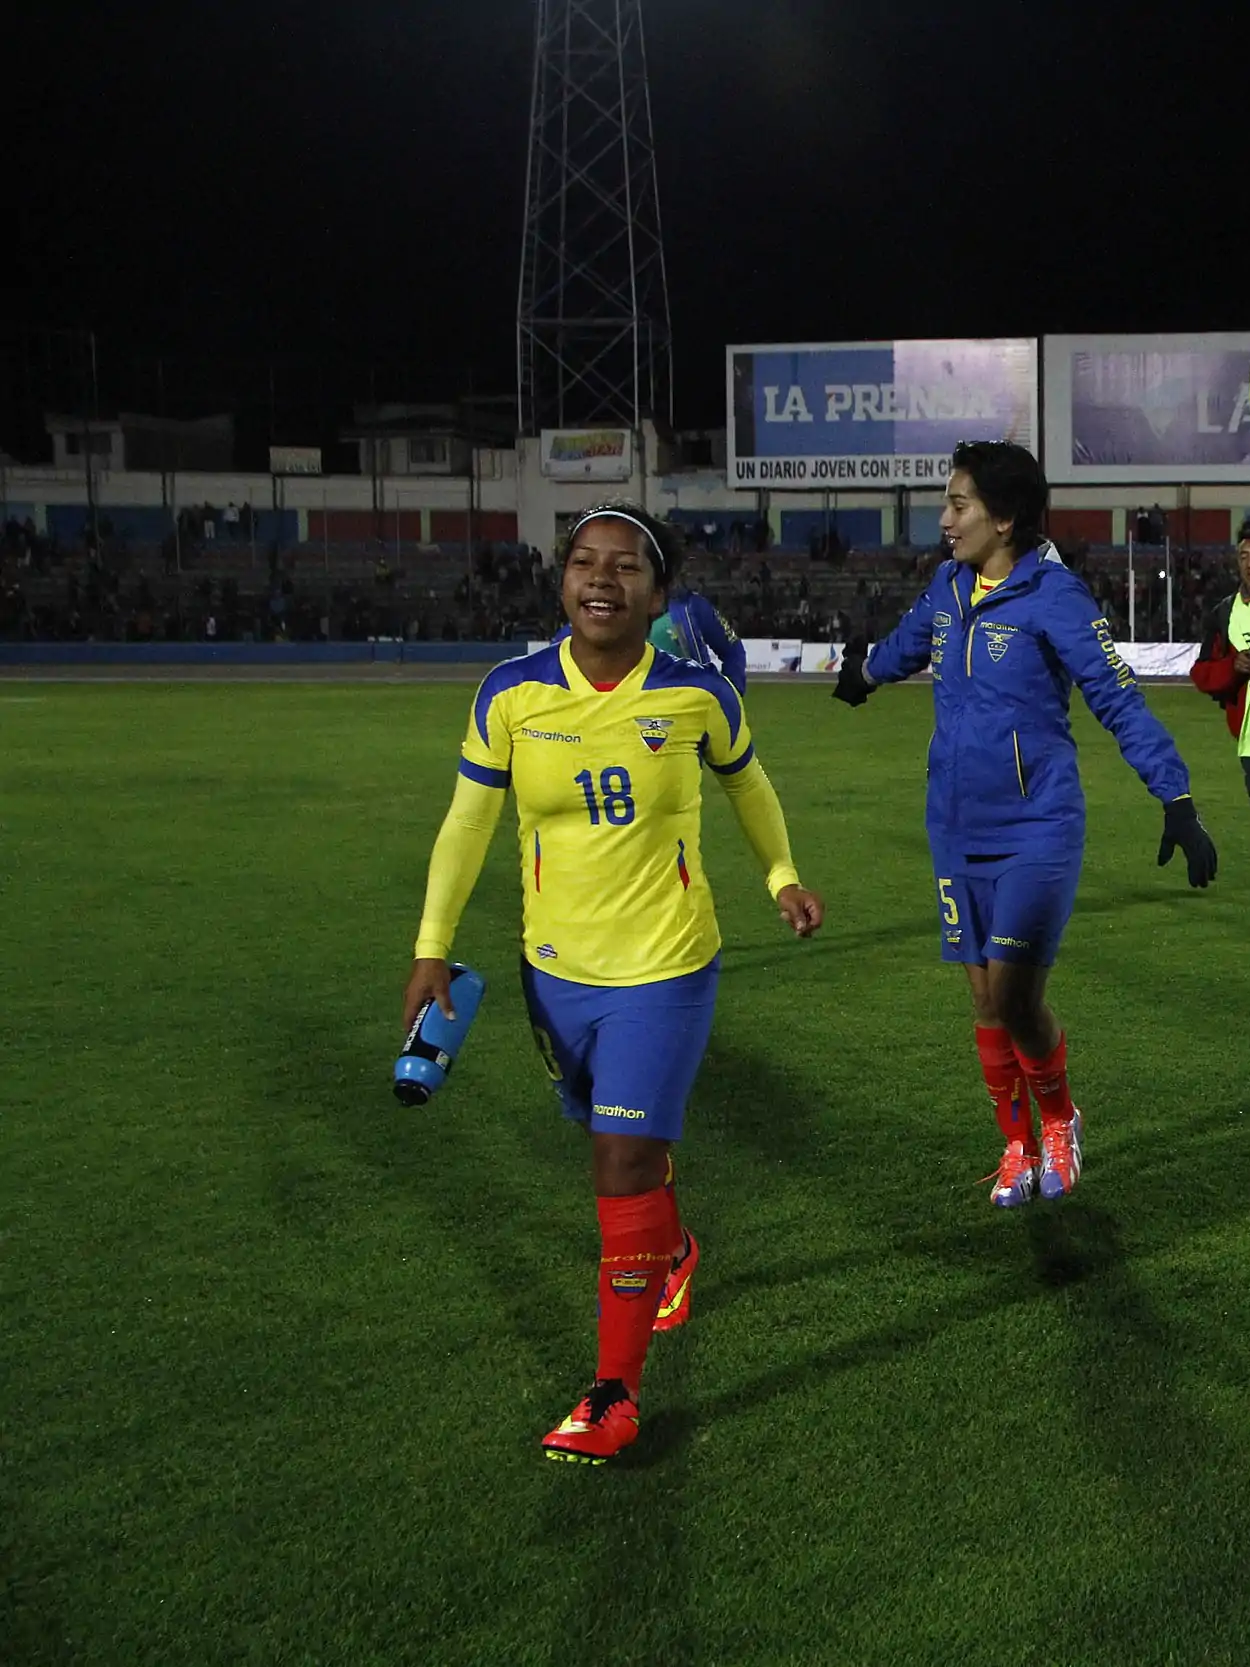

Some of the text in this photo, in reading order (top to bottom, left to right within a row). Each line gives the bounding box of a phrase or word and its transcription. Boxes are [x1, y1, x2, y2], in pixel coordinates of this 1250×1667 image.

[763, 383, 999, 423] LA PRENSA
[736, 461, 756, 480] UN
[759, 460, 806, 479] DIARIO
[810, 459, 856, 479] JOVEN
[860, 459, 890, 478] CON
[894, 459, 911, 478] FE
[915, 459, 934, 477] EN
[521, 727, 581, 744] marathon
[574, 766, 635, 826] 18
[593, 1103, 646, 1119] marathon
